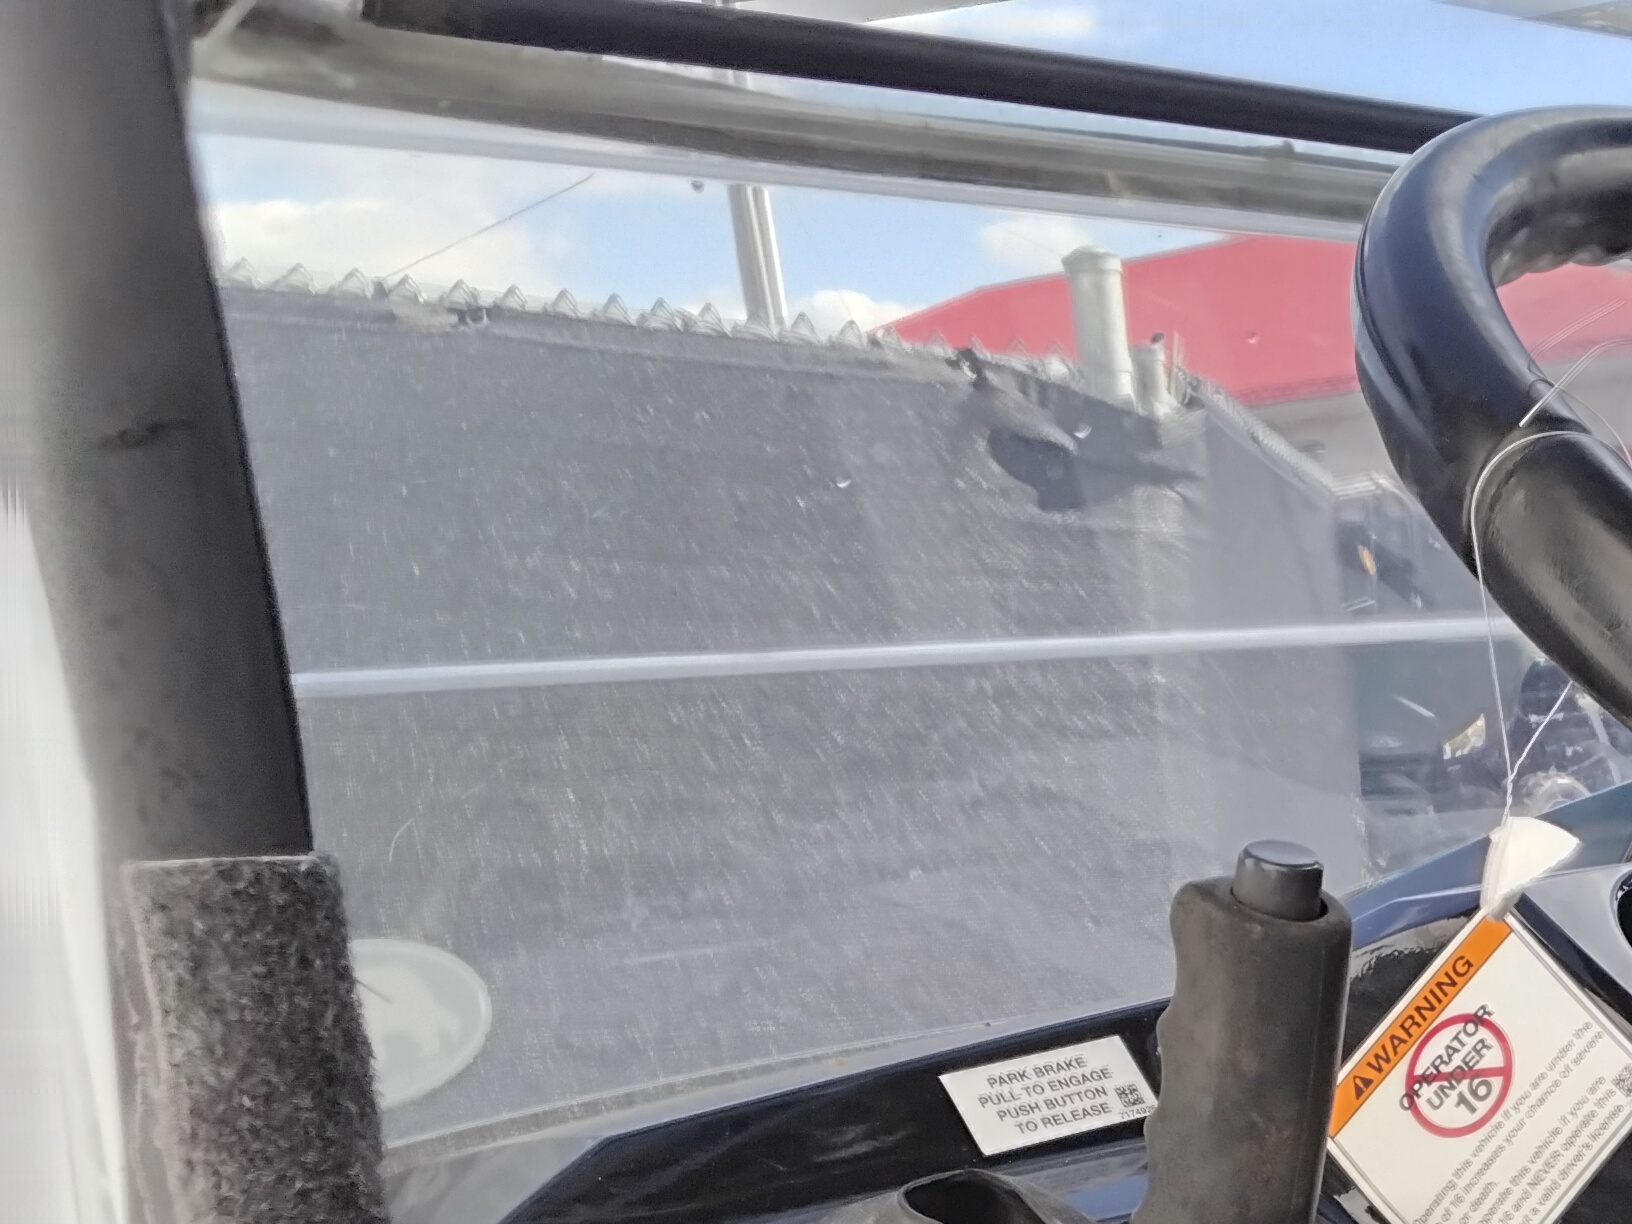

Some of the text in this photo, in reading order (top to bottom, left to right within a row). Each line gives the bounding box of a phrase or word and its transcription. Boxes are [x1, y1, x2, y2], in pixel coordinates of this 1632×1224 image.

[1366, 954, 1475, 1077] WARNING
[977, 1065, 1113, 1109] PULL TO ENGAGE
[986, 1054, 1088, 1089] PARK BRAKE
[1398, 1004, 1493, 1111] OPERATOR
[1425, 1037, 1493, 1110] UNDER
[1454, 1068, 1492, 1114] 16
[996, 1086, 1109, 1122] PUSH BUTTON
[1014, 1102, 1113, 1135] TO RELEASE
[1440, 1206, 1453, 1222] of
[1448, 1192, 1465, 1208] 16
[1460, 1143, 1506, 1195] increases
[1502, 1116, 1526, 1146] your
[1524, 1078, 1561, 1118] chance
[1558, 1063, 1573, 1079] of
[1570, 1030, 1604, 1066] severe
[1451, 1158, 1473, 1180] this
[1469, 1120, 1505, 1158] vehicle
[1509, 1089, 1532, 1113] you
[1528, 1071, 1548, 1090] are
[1544, 1038, 1575, 1071] under
[1572, 1021, 1593, 1040] the
[1508, 1165, 1531, 1186] this
[1526, 1126, 1563, 1164] vehicle
[1566, 1094, 1589, 1119] you
[1585, 1076, 1606, 1095] are
[1511, 1187, 1532, 1213] and
[1526, 1149, 1564, 1190] NEVER
[1560, 1109, 1598, 1151] operate
[1593, 1088, 1616, 1109] this
[1528, 1206, 1541, 1216] a
[1535, 1178, 1561, 1206] valid
[1557, 1141, 1593, 1181] driver's
[1468, 1180, 1499, 1213] death.
